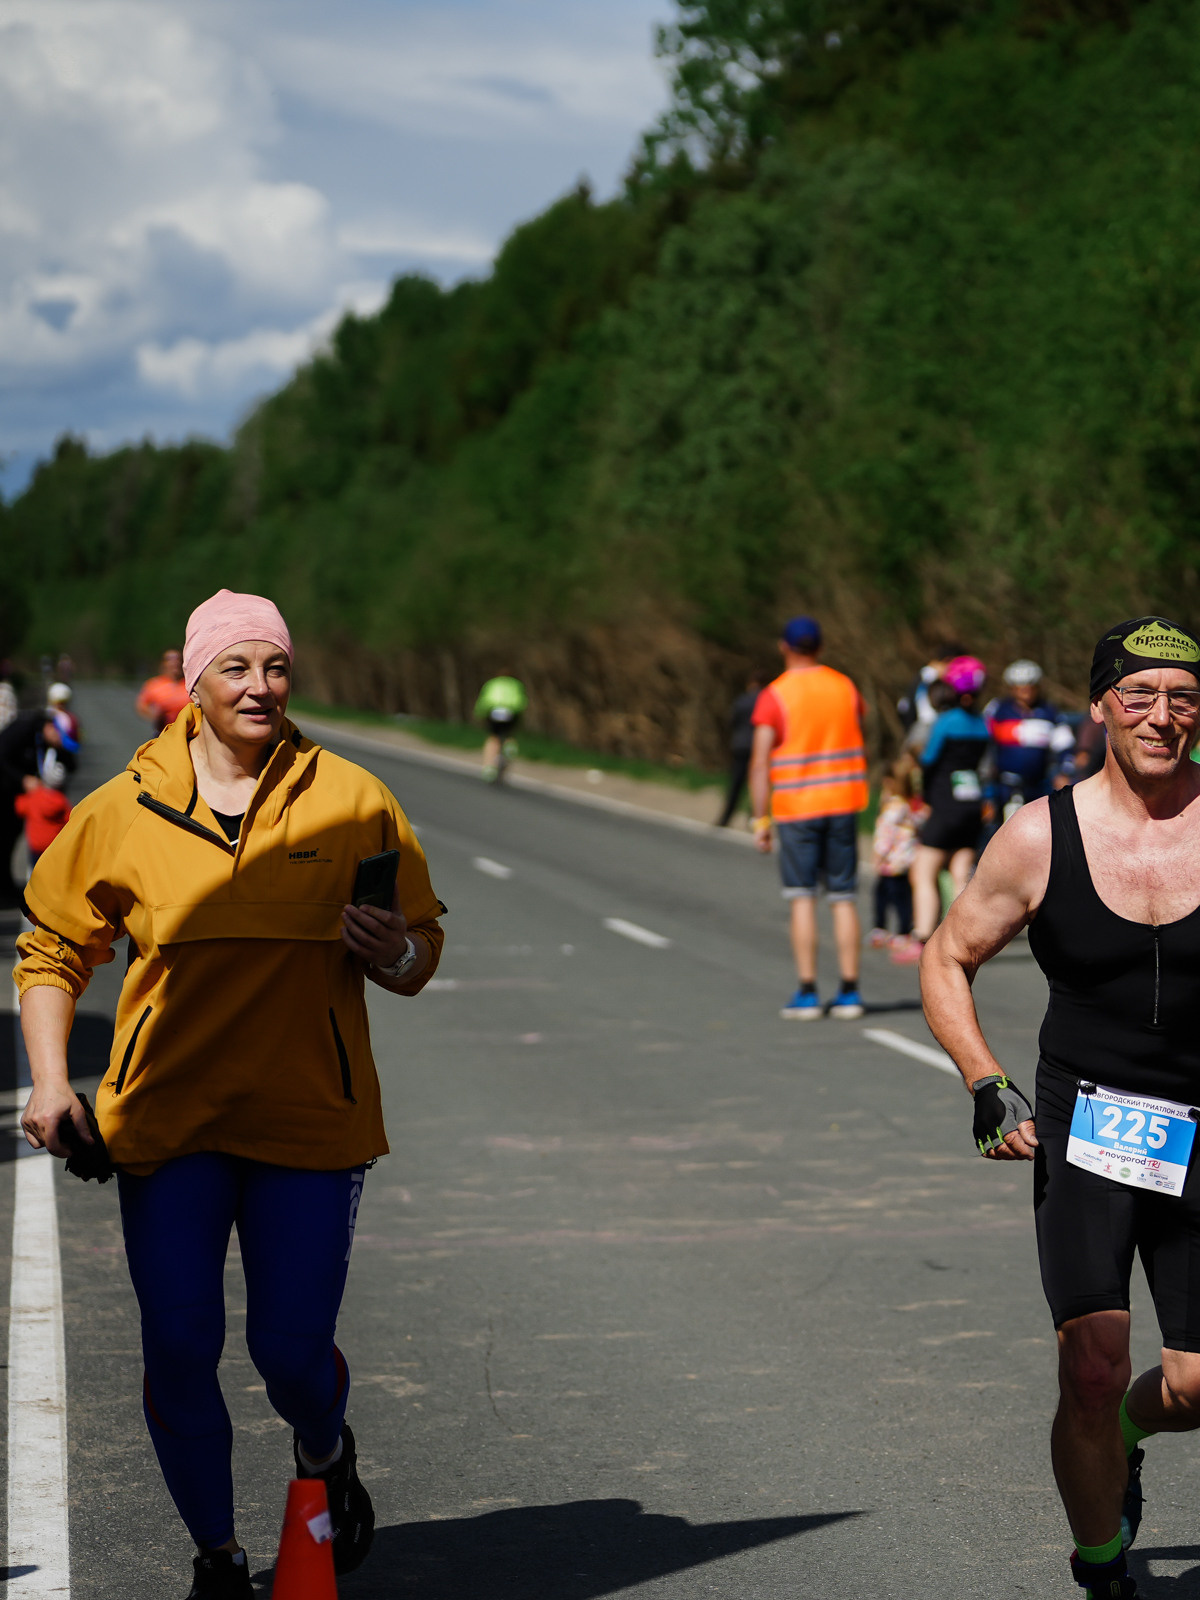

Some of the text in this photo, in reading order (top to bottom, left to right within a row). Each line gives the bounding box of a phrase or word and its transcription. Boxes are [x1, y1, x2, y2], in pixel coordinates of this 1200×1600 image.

[1132, 635, 1197, 652] Красная
[1090, 1092, 1141, 1106] ОВГОРОДСКИЙ
[1142, 1102, 1176, 1115] ТРИАТЛОН
[1098, 1105, 1171, 1149] 225
[1113, 1141, 1148, 1156] Валерий
